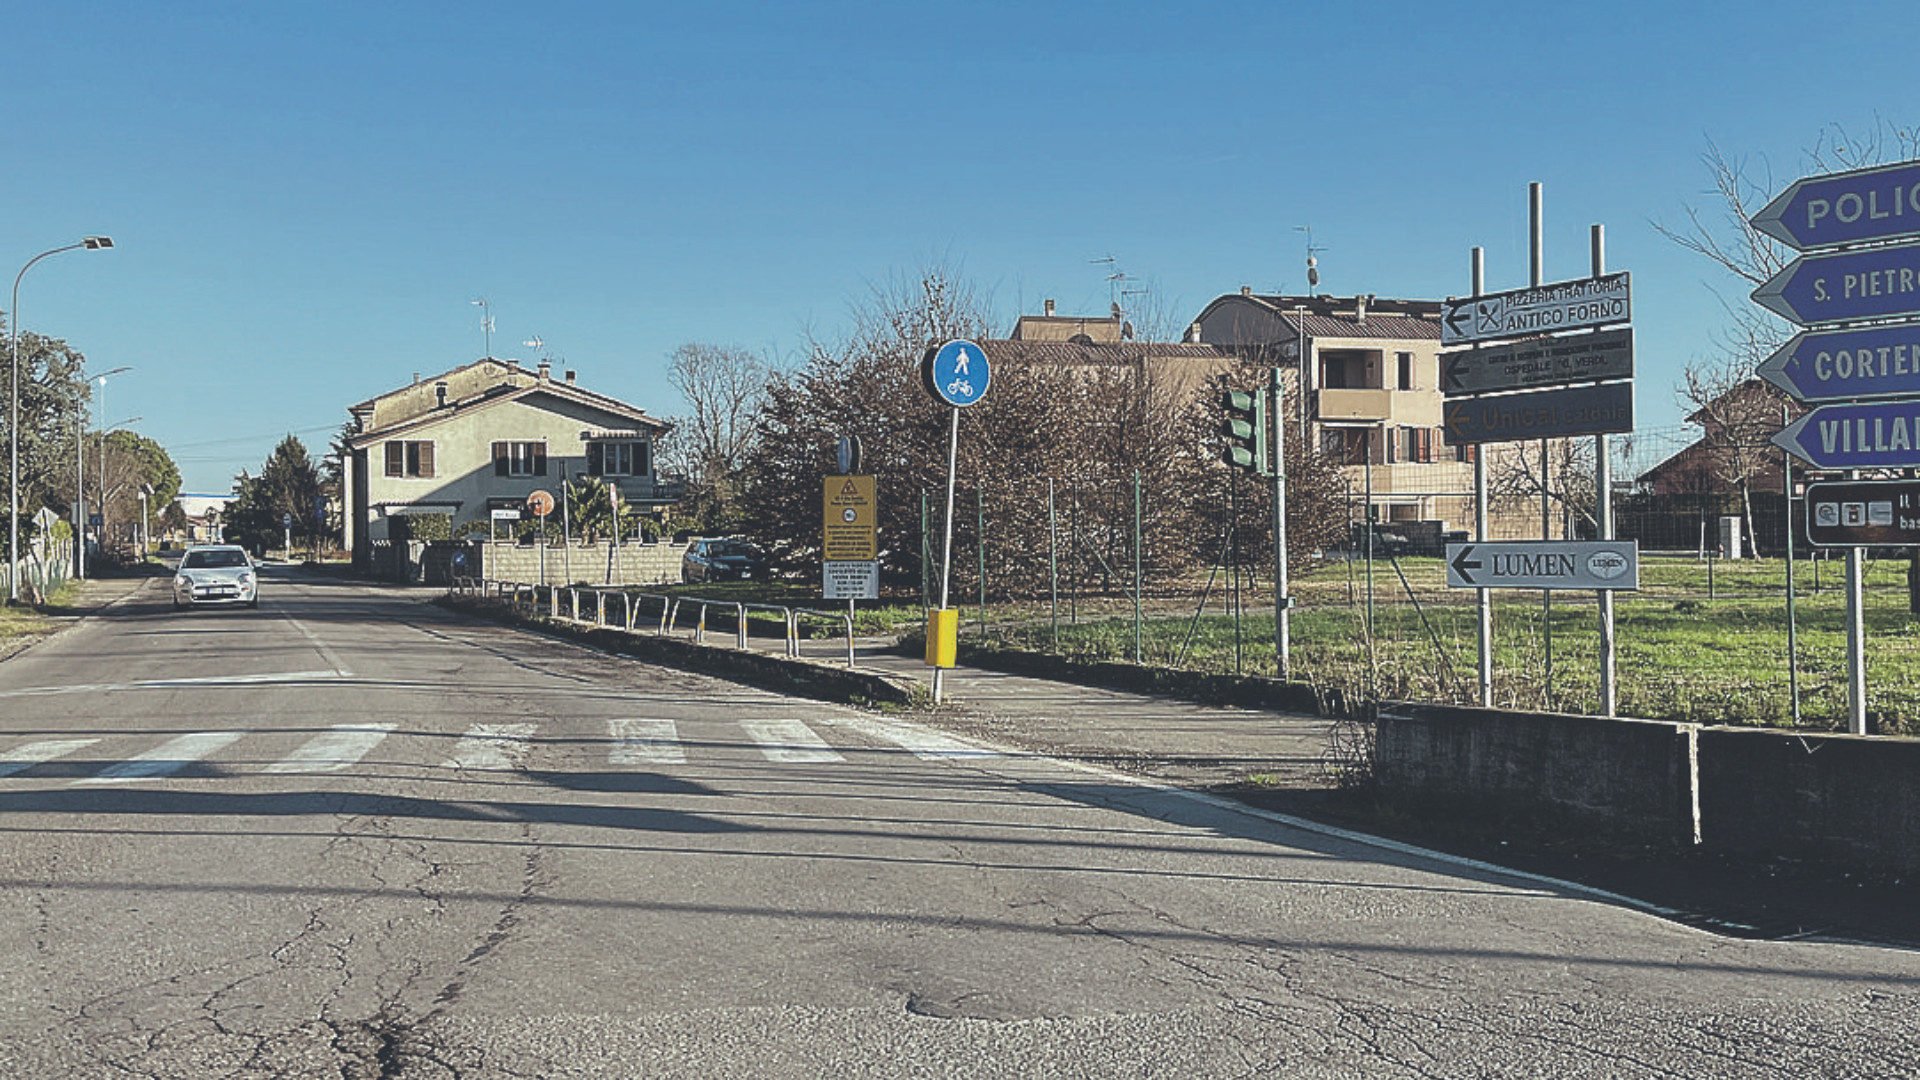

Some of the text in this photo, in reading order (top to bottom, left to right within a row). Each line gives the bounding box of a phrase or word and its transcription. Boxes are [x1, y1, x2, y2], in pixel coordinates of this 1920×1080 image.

[1814, 267, 1920, 301] S. PIETR
[1506, 289, 1555, 308] PIZZERIA
[1507, 300, 1623, 331] ANTICO FORNO
[1492, 554, 1623, 576] LUMEN LUMEN
